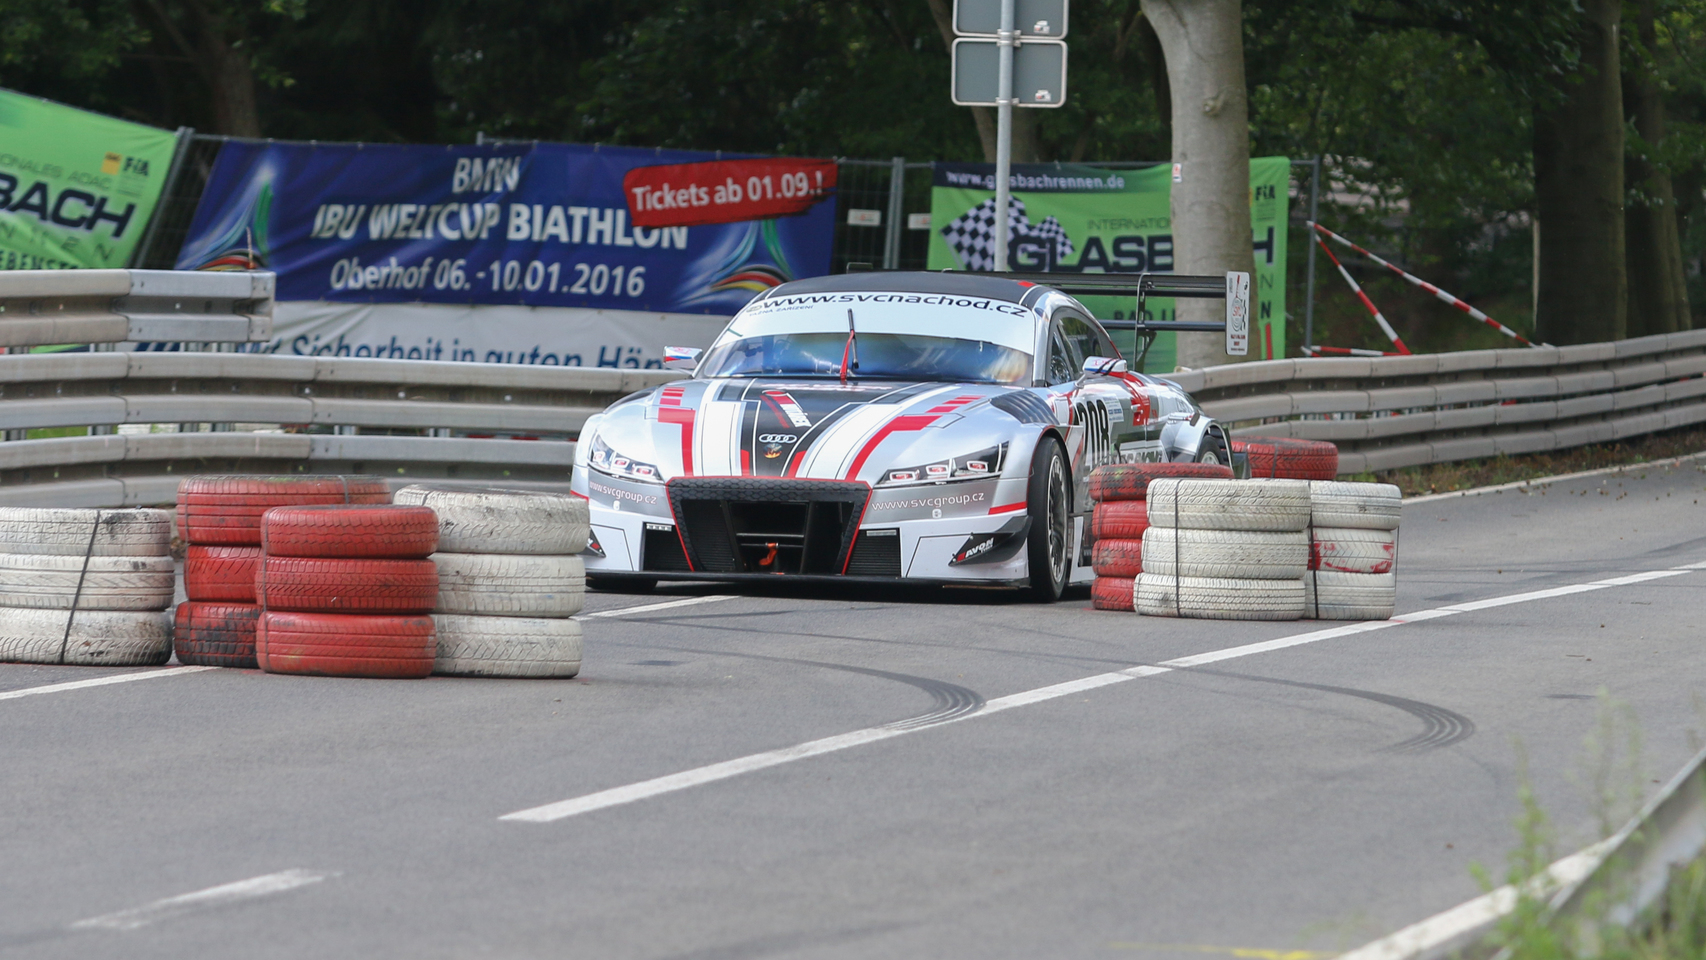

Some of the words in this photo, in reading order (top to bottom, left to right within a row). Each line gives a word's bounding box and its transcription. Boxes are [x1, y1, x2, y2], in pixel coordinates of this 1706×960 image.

[451, 156, 522, 194] BMW
[632, 183, 711, 212] Tickets
[713, 177, 743, 205] ab
[747, 170, 823, 202] 01.09.!
[945, 171, 1126, 189] www.gsbachrennen.de
[310, 203, 368, 241] IBU
[367, 203, 501, 241] WELTCUP
[506, 202, 689, 250] BIATHLON
[330, 256, 435, 290] Oberhof
[763, 294, 1028, 318] www.svcnachod.cz
[453, 338, 476, 363] in
[596, 345, 665, 370] Hän
[1073, 399, 1111, 466] 208
[589, 481, 658, 505] www.svcgroup.cz
[871, 492, 985, 510] www.svcgroup.cz
[965, 537, 994, 559] AVON
